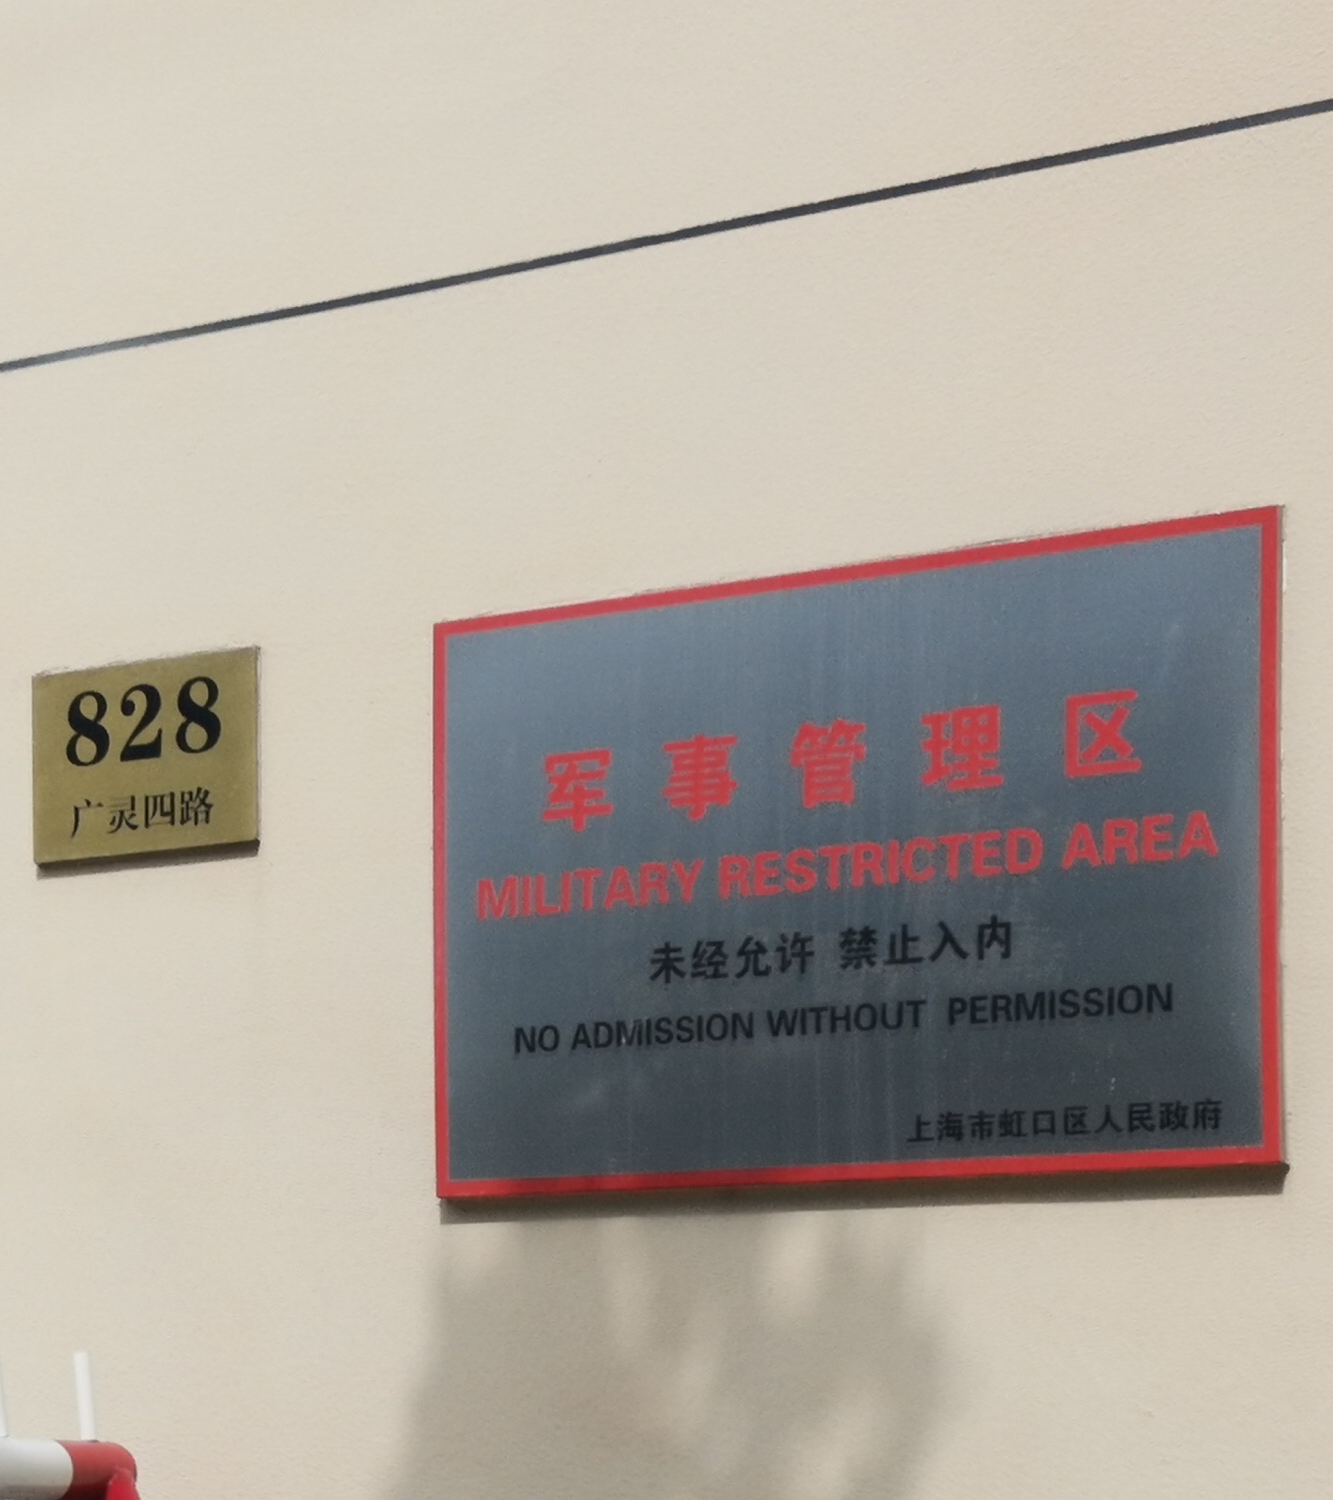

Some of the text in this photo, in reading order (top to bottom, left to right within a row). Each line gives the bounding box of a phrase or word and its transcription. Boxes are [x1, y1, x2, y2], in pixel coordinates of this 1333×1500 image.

[66, 676, 221, 766] 828
[542, 689, 1142, 831] 军事管理区
[71, 786, 214, 838] 广灵四路
[476, 811, 1218, 920] MILITARY RESTRICTED AREA
[649, 916, 1014, 985] 未经允许 禁止入内
[513, 983, 1175, 1055] NO ADMISSION WITHOUT PERMISSION
[906, 1098, 1223, 1145] 上海市虹口区人民政府
